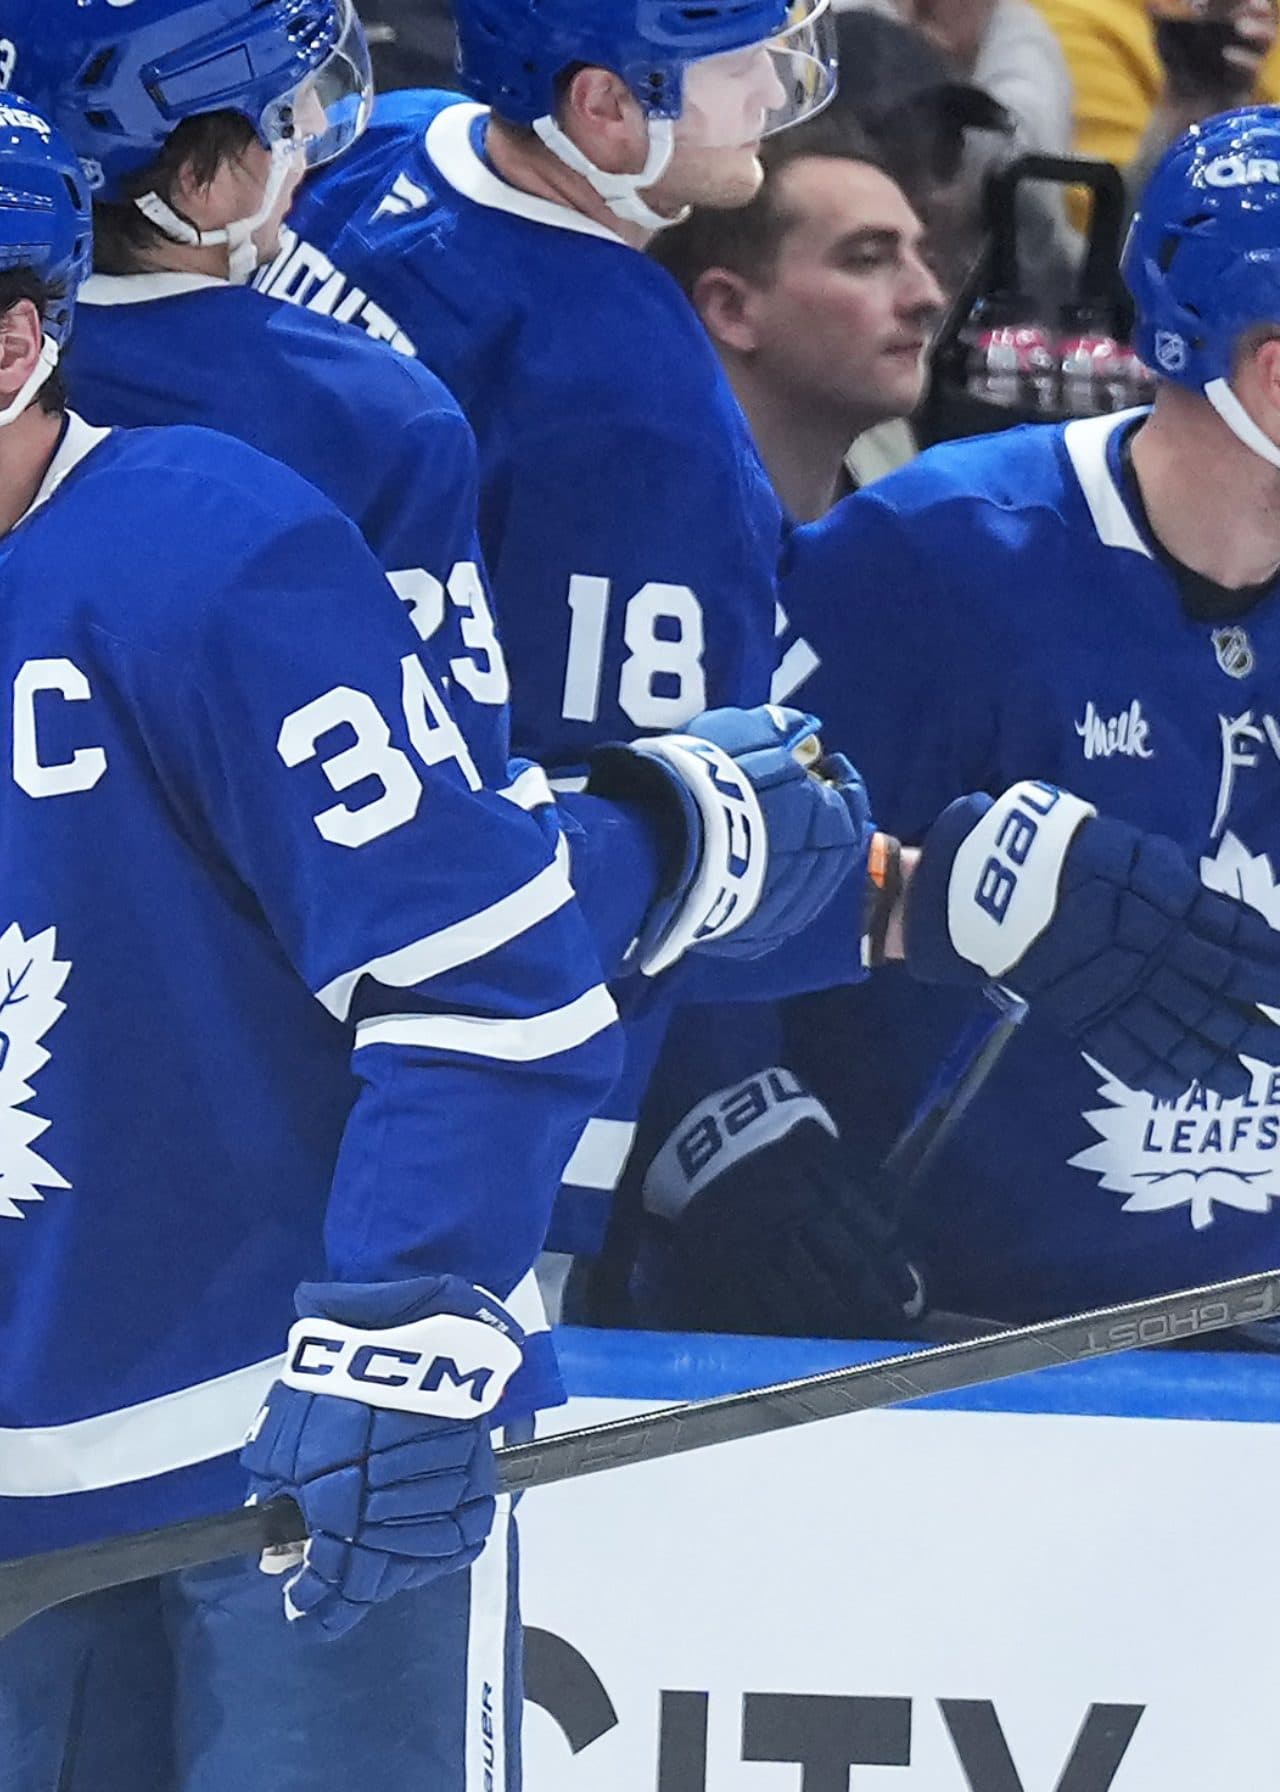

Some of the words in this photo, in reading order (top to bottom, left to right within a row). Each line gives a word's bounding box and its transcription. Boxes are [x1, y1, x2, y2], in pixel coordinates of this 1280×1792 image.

[561, 573, 707, 729] 18
[12, 658, 107, 798] C
[276, 653, 484, 849] 34
[1073, 699, 1154, 760] Milk
[1141, 1115, 1280, 1154] LEAFS
[1081, 1302, 1229, 1356] GHOST
[291, 1335, 496, 1403] CCM
